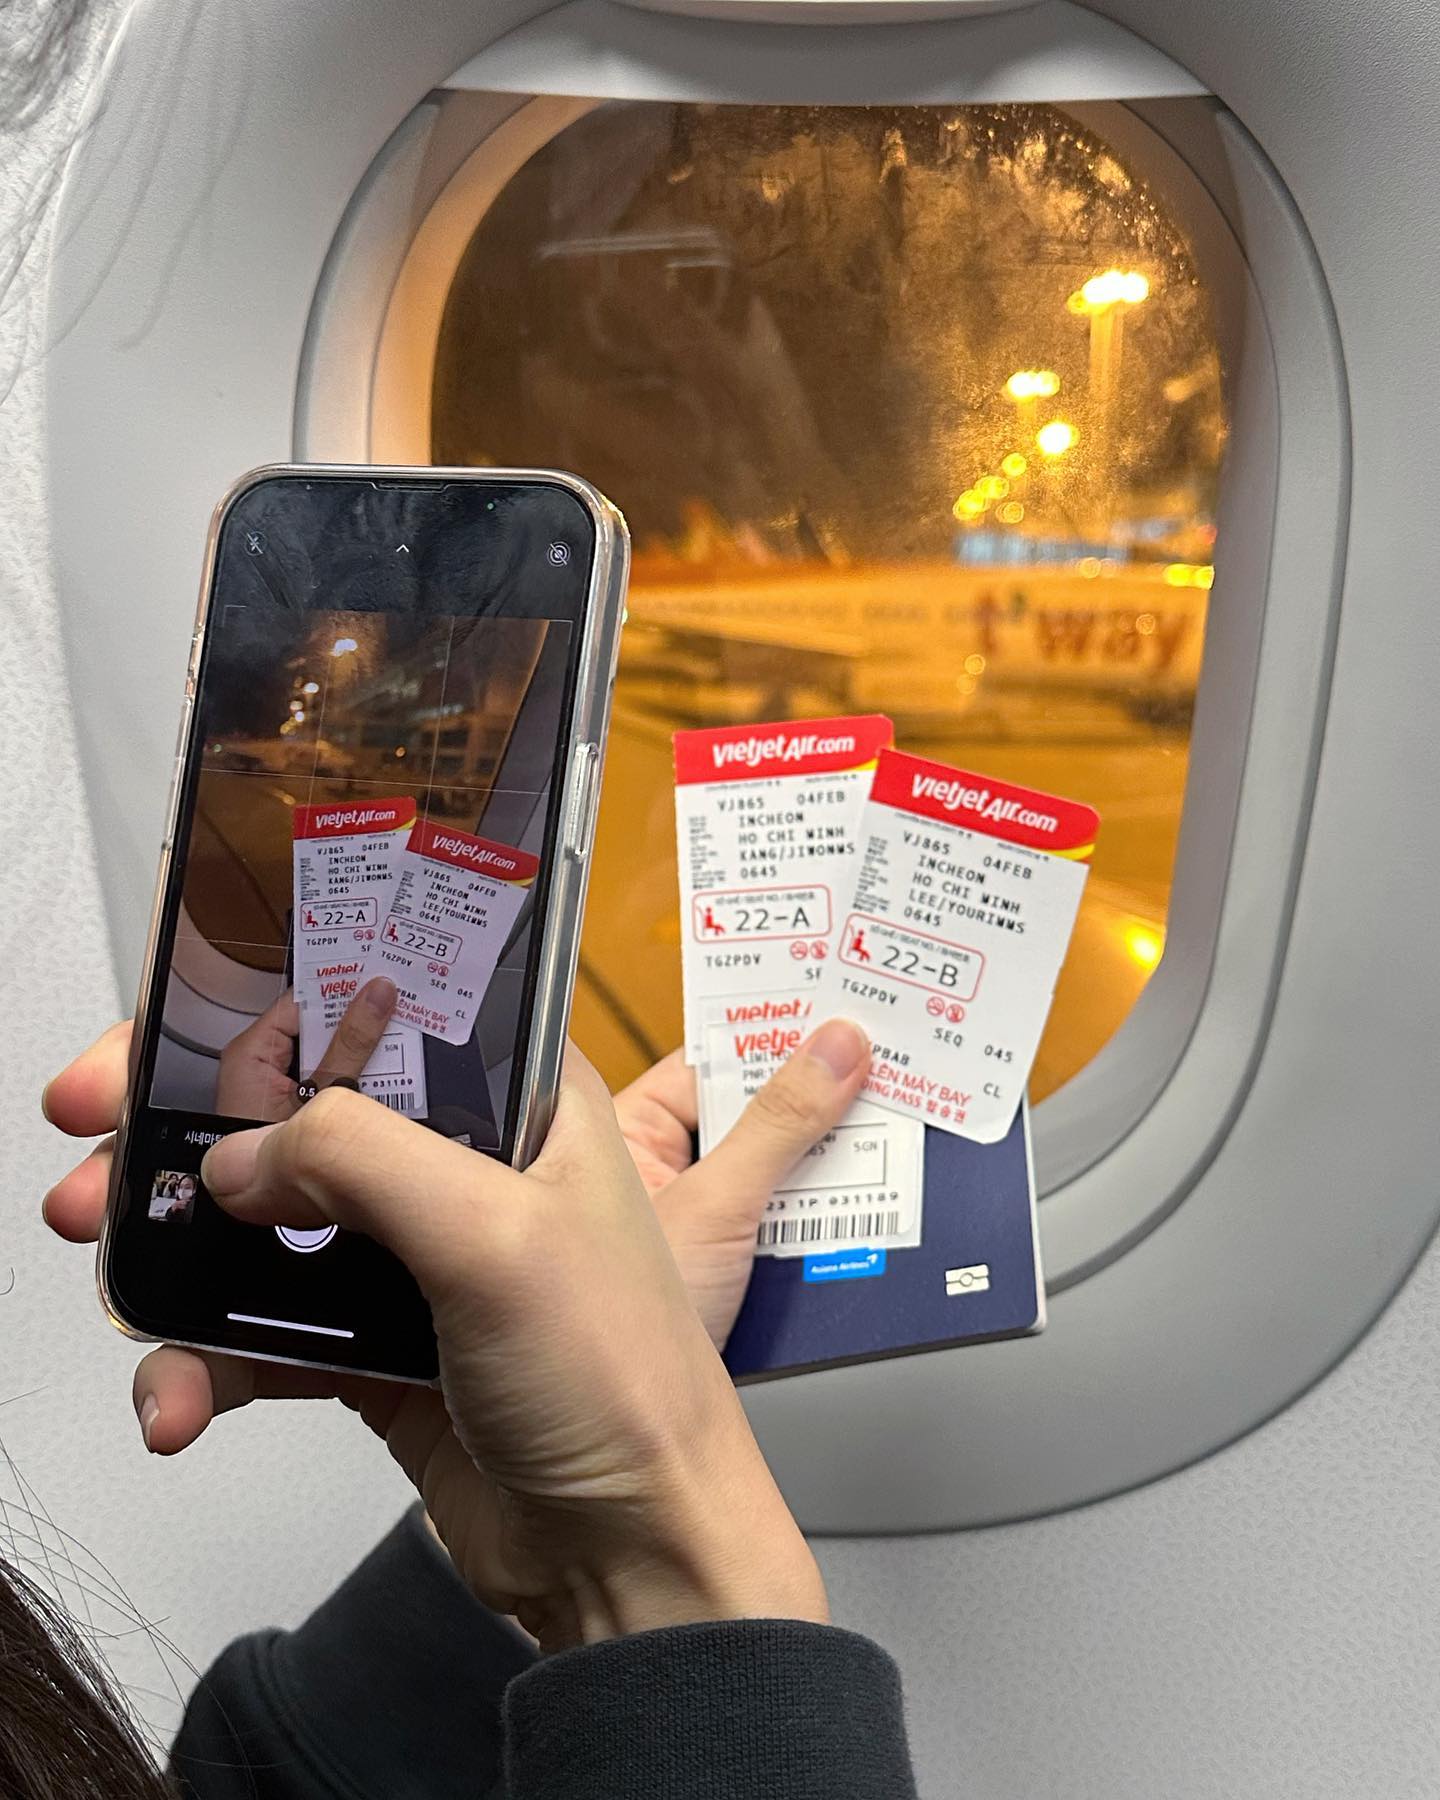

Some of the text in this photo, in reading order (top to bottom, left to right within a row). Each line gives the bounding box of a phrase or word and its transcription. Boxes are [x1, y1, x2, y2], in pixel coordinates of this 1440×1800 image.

[718, 791, 845, 811] VJ865 04FEB
[739, 813, 804, 826] INCHEON
[739, 833, 757, 844] HO
[768, 830, 795, 842] CHI
[318, 846, 344, 855] VJ865
[903, 831, 1032, 880] VJ865 04FEB
[329, 855, 366, 864] INCHEON
[328, 867, 339, 875] HO
[344, 865, 360, 874] CHI
[740, 866, 777, 879] 0645
[918, 854, 986, 883] INCHEON
[328, 886, 350, 895] 0645
[423, 868, 497, 897] VJ865 04FEB
[430, 882, 469, 900] INCHEON
[912, 872, 1020, 914] HO CHI MINH
[426, 892, 438, 901] HO
[442, 897, 459, 908] CHI
[324, 910, 366, 925] 22-A
[419, 911, 441, 924] 0645
[735, 907, 810, 932] 22-A
[904, 906, 941, 926] 0645
[306, 937, 338, 946] TGZPDV
[404, 932, 448, 957] 22-B
[381, 950, 412, 967] TGZPDV
[706, 953, 761, 968] TGZPDV
[882, 945, 960, 988] 22-B
[431, 979, 473, 999] SEQ 045
[842, 978, 898, 1005] TGZPDV
[405, 1012, 421, 1024] PASS
[431, 1012, 449, 1023] BAY
[455, 1009, 466, 1019] CL
[933, 1027, 1014, 1063] SEQ 045
[298, 1086, 316, 1098] 0.5
[902, 1071, 936, 1093] MÁY
[938, 1087, 971, 1108] BAY
[983, 1082, 1002, 1098] CL
[892, 1089, 922, 1109] PASS
[853, 1140, 878, 1153] SGN
